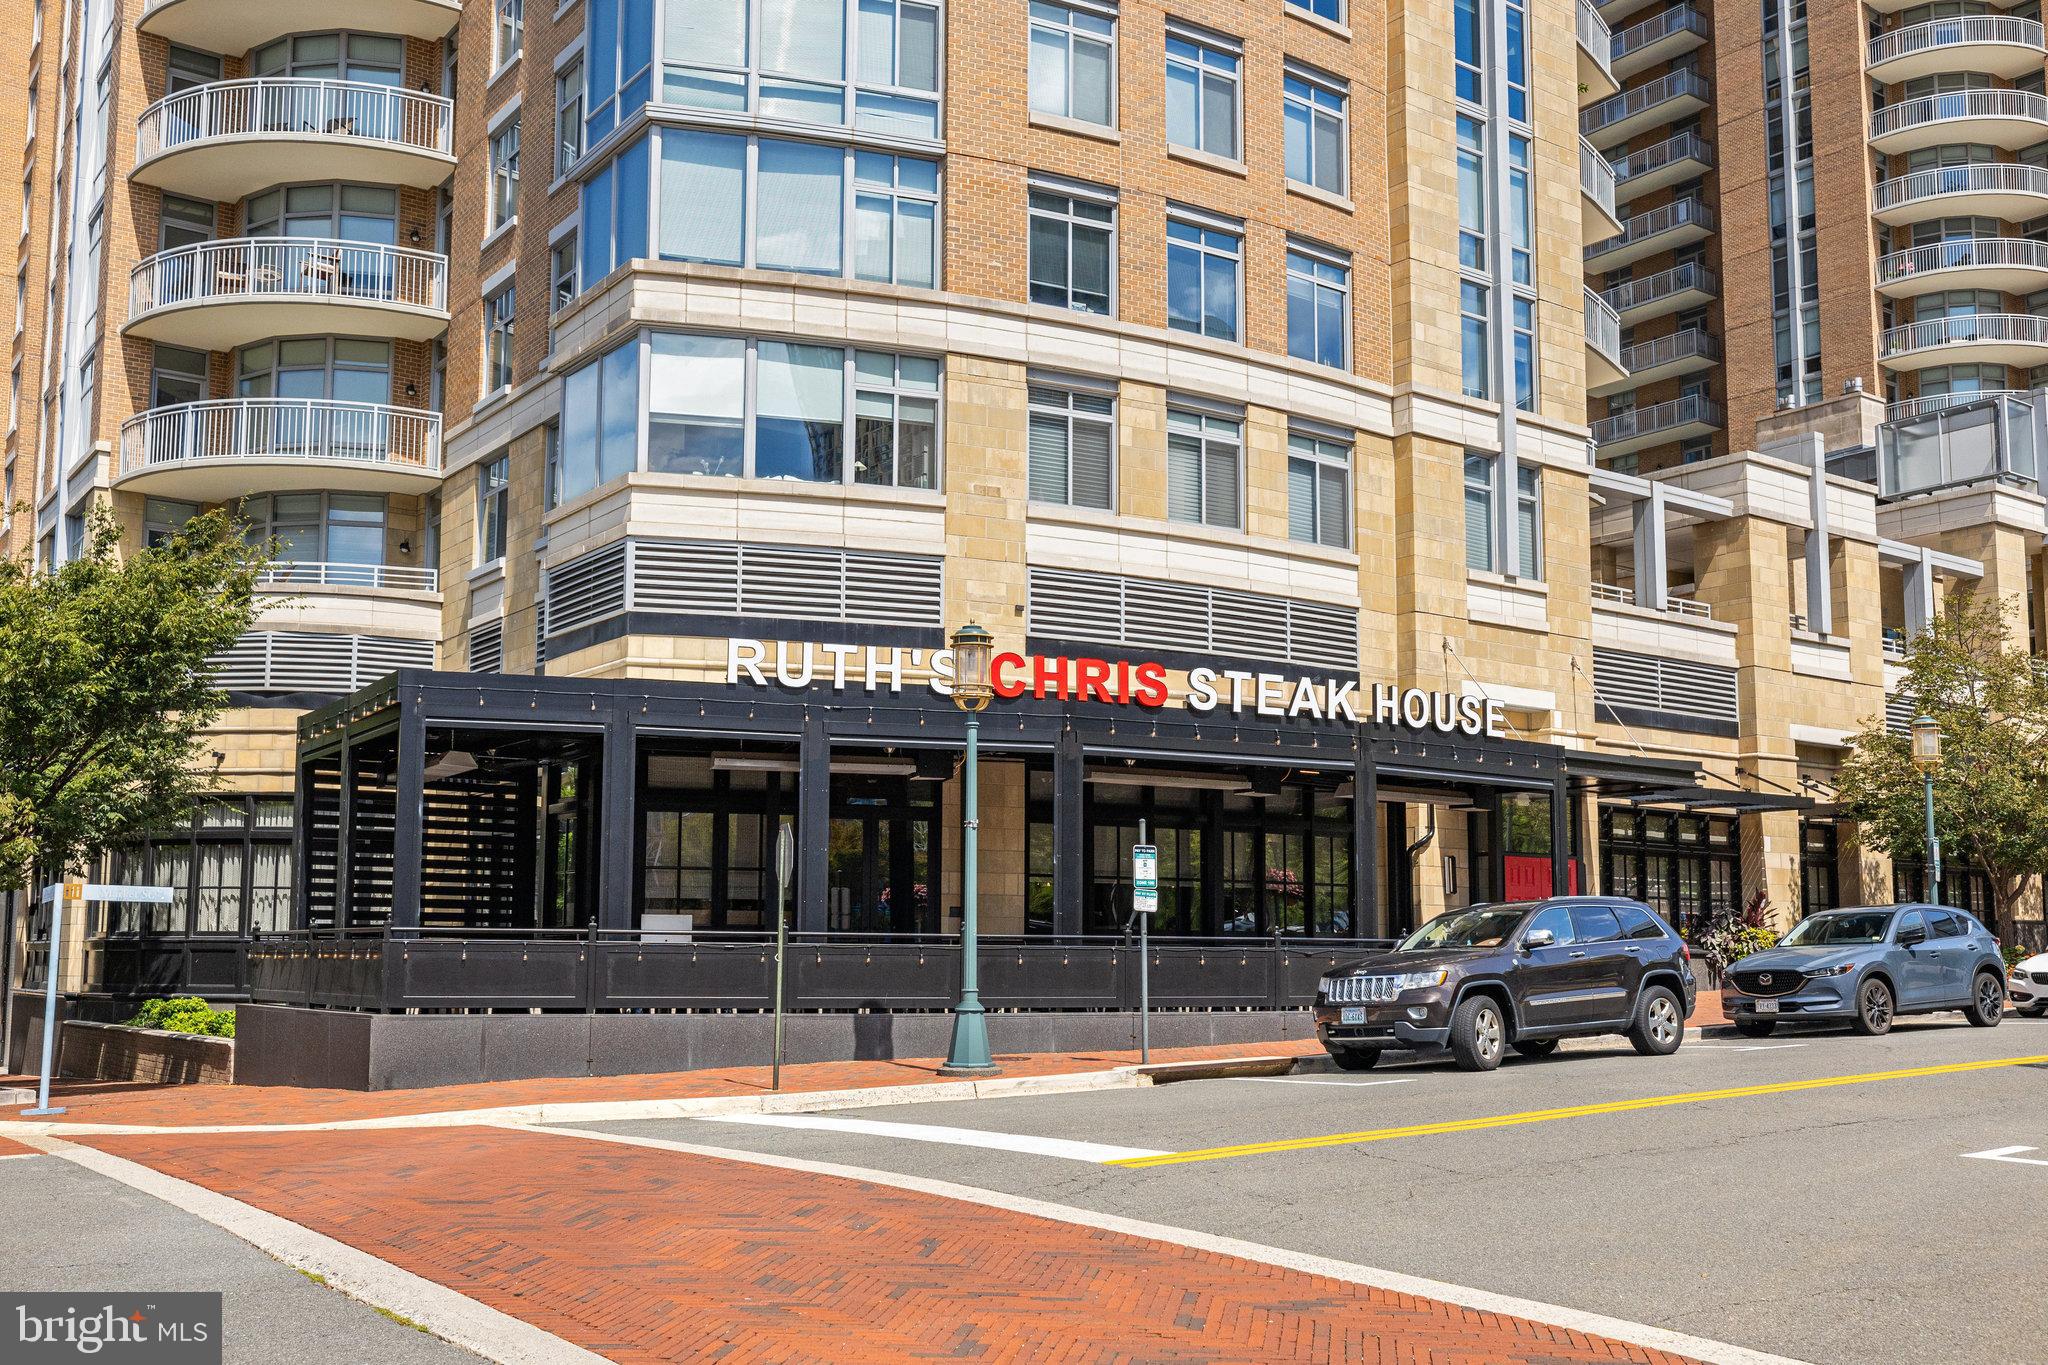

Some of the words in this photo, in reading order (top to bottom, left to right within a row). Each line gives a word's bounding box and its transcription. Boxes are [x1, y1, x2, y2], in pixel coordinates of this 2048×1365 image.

[726, 638, 956, 695] RUTH'S
[989, 652, 1168, 707] CHRIS
[1188, 667, 1357, 721] STEAK
[1372, 683, 1506, 737] HOUSE
